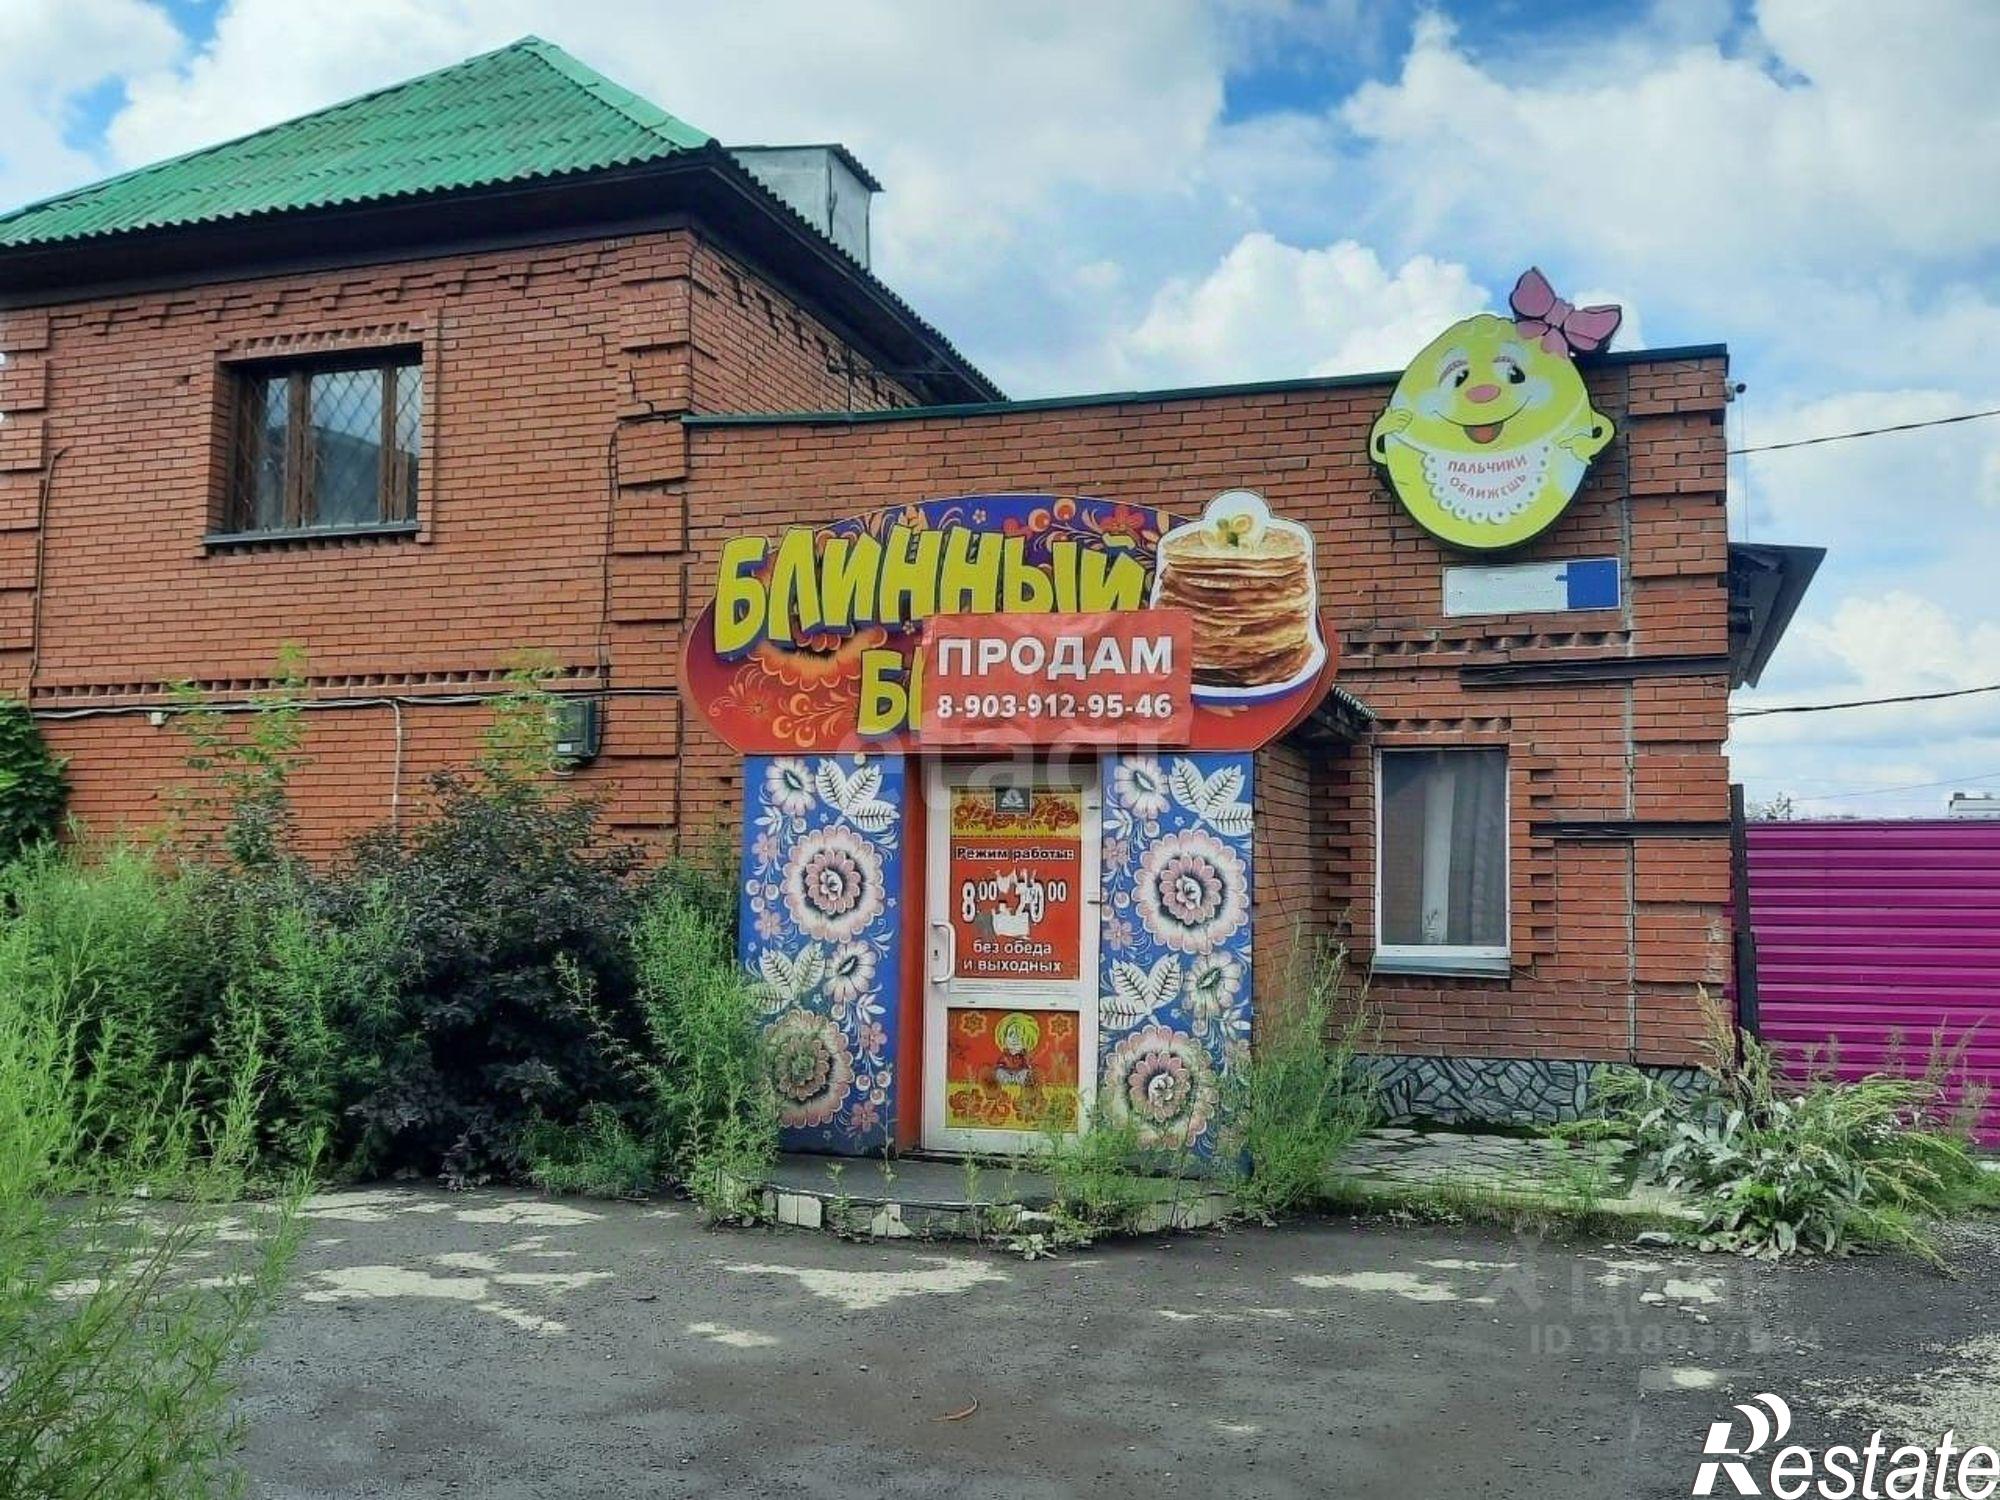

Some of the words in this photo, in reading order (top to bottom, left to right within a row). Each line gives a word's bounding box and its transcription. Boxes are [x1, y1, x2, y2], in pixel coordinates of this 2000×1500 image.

[1447, 454, 1528, 474] ПАЛЬЧИКИ
[1449, 475, 1527, 499] ОБЛИЖЕШЬ
[713, 526, 1146, 656] БЛИННЫЙ
[936, 636, 1173, 681] ПРОДАМ
[936, 694, 1173, 719] 8-903-912-95-46
[956, 848, 1008, 860] Режим
[1012, 847, 1074, 862] работы:
[973, 940, 999, 954] без
[1004, 941, 1052, 955] обеда
[978, 961, 1062, 973] выходных
